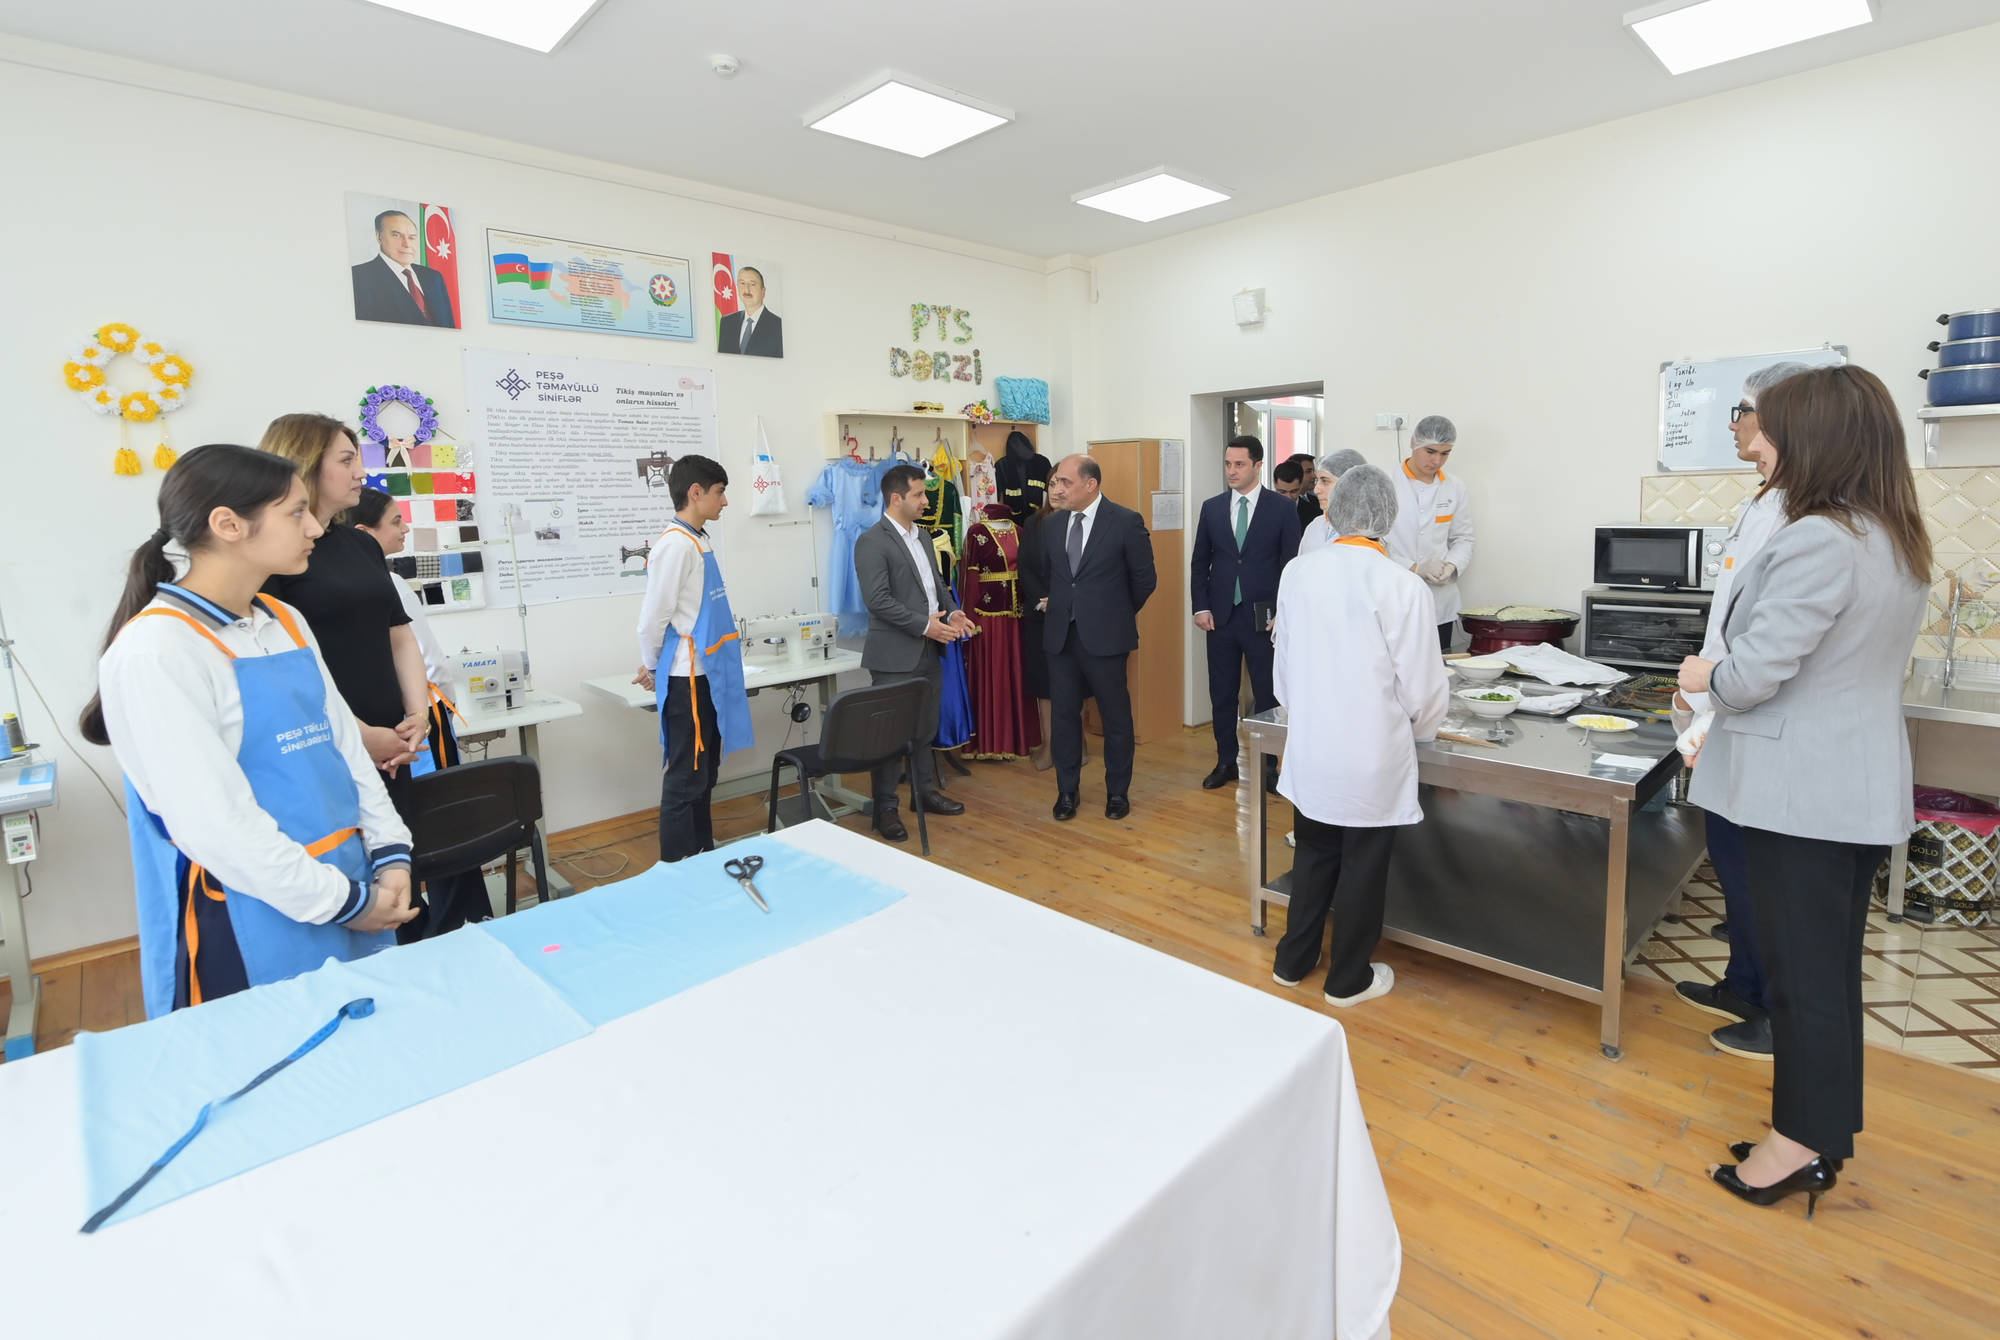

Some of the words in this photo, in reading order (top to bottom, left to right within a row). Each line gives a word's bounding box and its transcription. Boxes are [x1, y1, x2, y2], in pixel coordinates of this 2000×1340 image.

[911, 303, 972, 344] PTS
[536, 371, 564, 381] PEŞƏ
[536, 382, 599, 392] TƏMAYÜLLÜ
[616, 388, 634, 396] Tikiş
[538, 392, 582, 403] SİNİFLƏR
[462, 660, 496, 668] YAMATA
[1911, 845, 1938, 857] GOLD
[1953, 901, 1975, 909] GOLD
